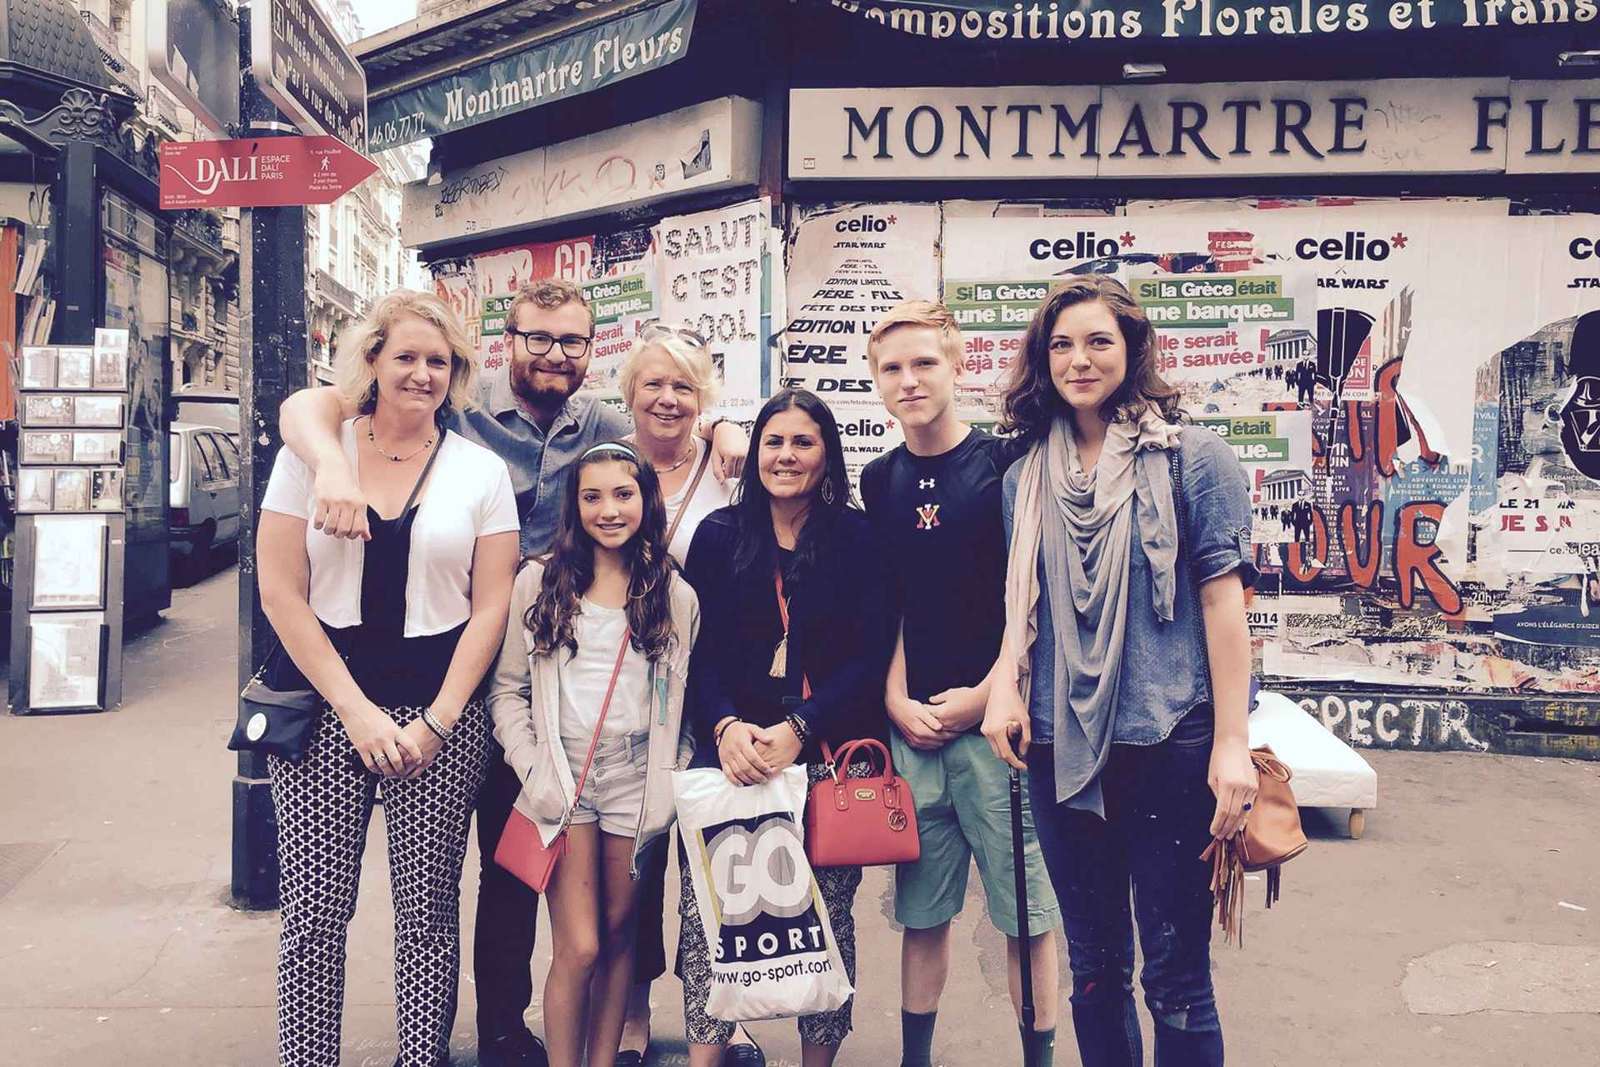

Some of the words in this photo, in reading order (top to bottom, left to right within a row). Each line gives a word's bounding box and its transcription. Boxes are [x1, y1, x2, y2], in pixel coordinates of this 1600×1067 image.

[1160, 0, 1369, 38] Florales
[1388, 0, 1436, 29] et
[286, 20, 311, 67] Musée
[443, 58, 584, 126] Montmartre
[592, 26, 683, 80] Fleurs
[287, 56, 300, 88] Par
[302, 73, 309, 99] la
[311, 90, 322, 114] rue
[325, 102, 335, 129] des
[385, 122, 397, 143] 06
[842, 96, 1369, 161] MONTMARTRE
[261, 154, 291, 164] ESPACE
[261, 163, 280, 172] DALÍ
[261, 172, 284, 181] PARIS
[665, 214, 757, 260] SALUT
[592, 283, 621, 299] Grèce
[622, 279, 643, 293] était
[976, 286, 992, 300] la
[996, 283, 1048, 300] Grèce
[1140, 283, 1157, 298] Si
[1161, 282, 1177, 298] la
[1181, 281, 1235, 297] Grèce
[1237, 280, 1278, 296] était
[1342, 278, 1389, 290] WARS
[871, 290, 904, 301] FILS
[955, 308, 997, 323] une
[595, 324, 624, 342] serait
[1183, 331, 1239, 349] serait
[488, 341, 504, 354] elle
[594, 338, 633, 359] sauvée
[1182, 348, 1254, 368] sauvée
[816, 378, 873, 393] DES
[1232, 421, 1272, 436] était
[1523, 498, 1540, 509] 21
[1247, 612, 1278, 624] 2014
[709, 824, 814, 916] GO
